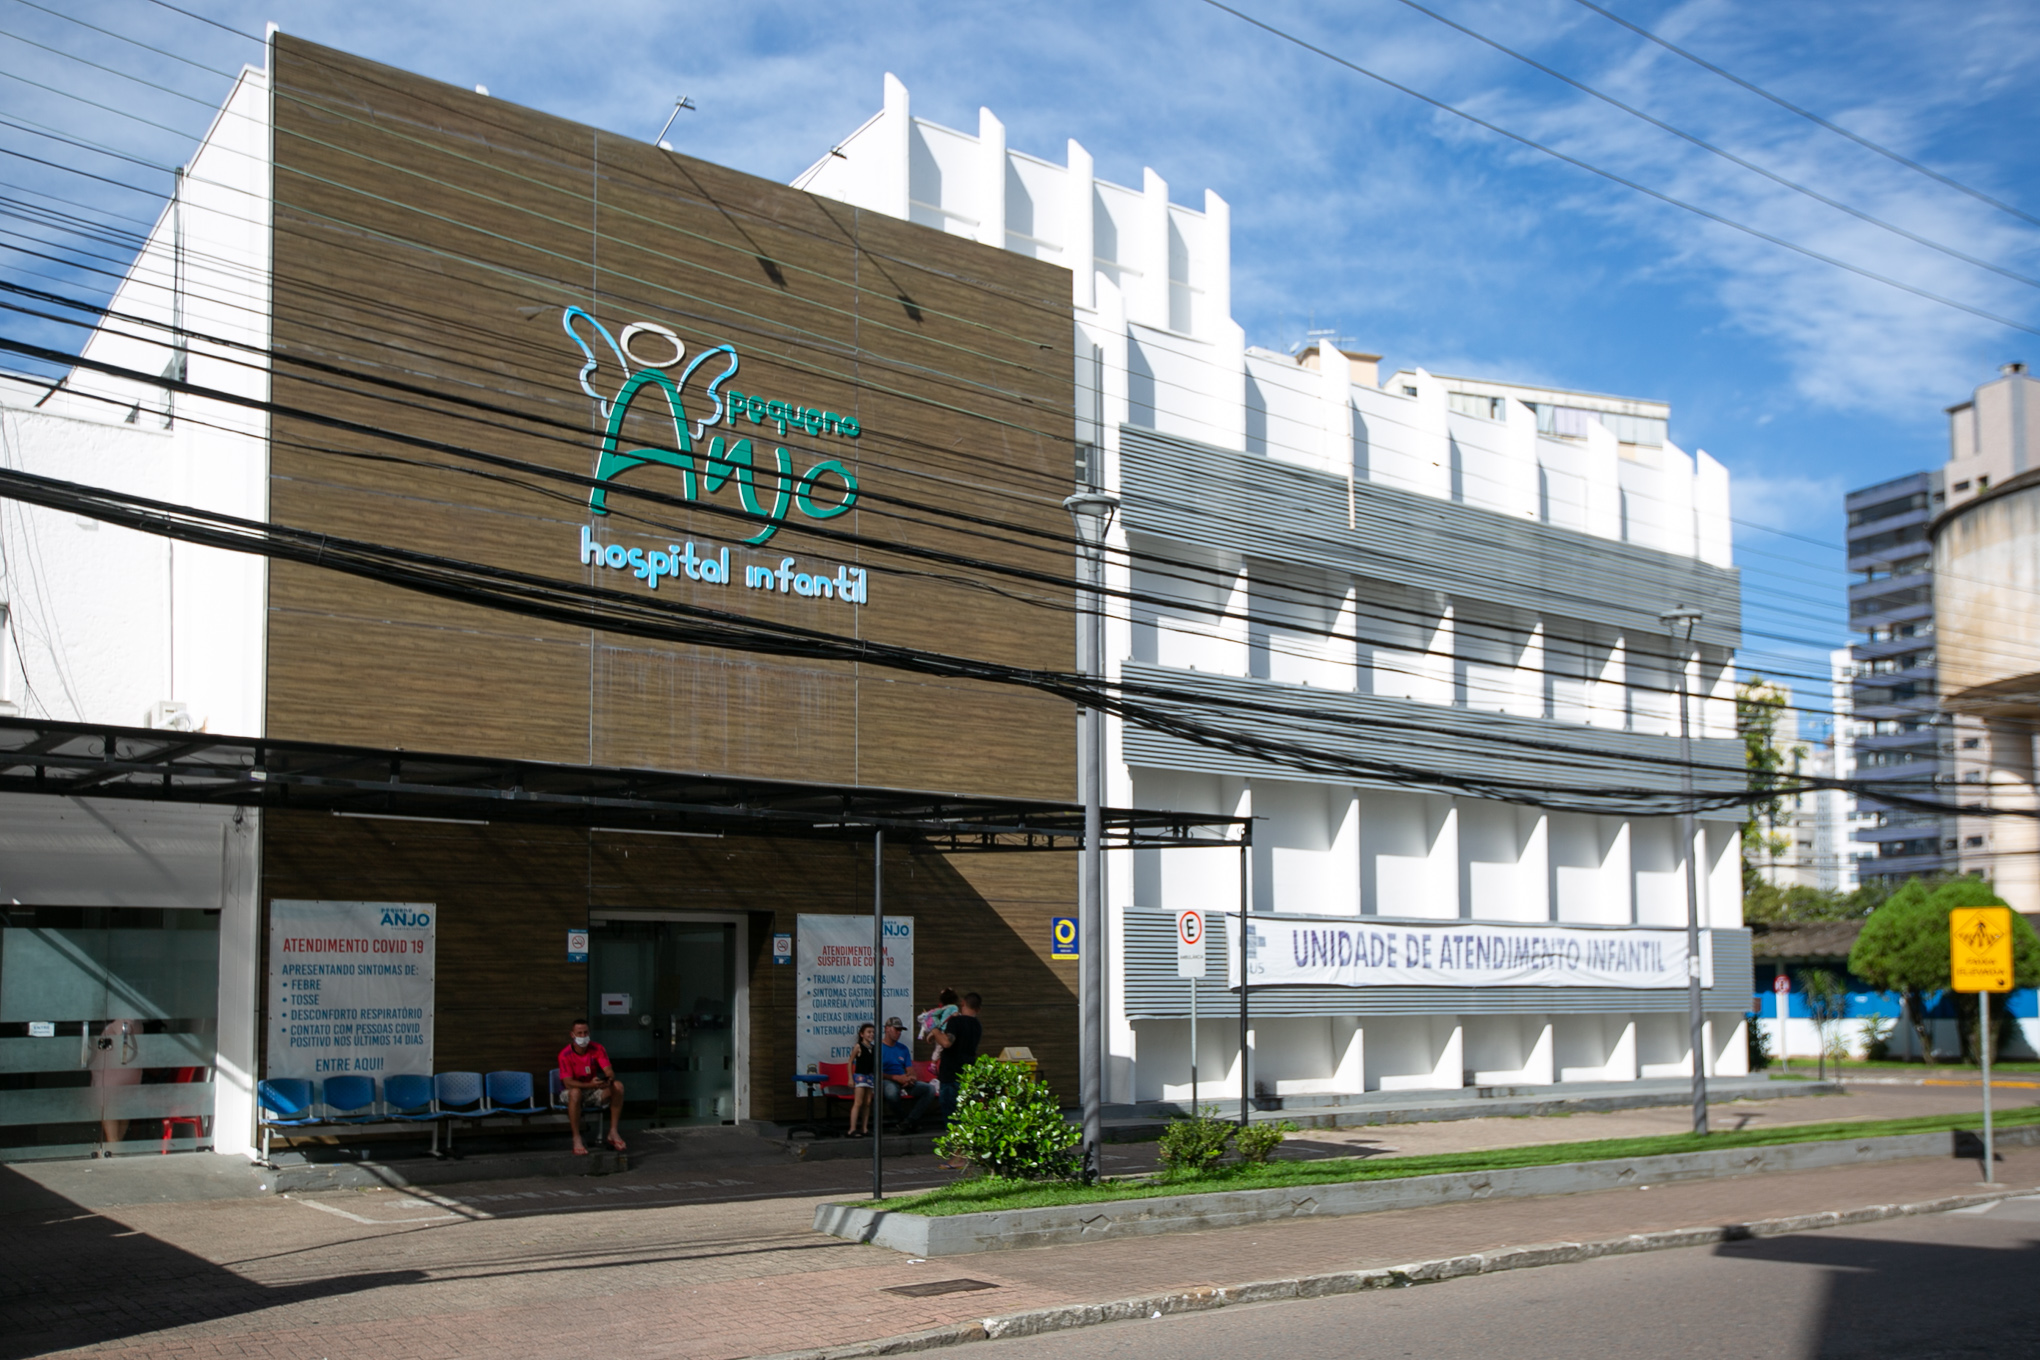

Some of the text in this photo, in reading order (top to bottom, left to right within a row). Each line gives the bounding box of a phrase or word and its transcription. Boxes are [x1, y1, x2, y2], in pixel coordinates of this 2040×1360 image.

[581, 525, 867, 605] hospital infantil
[380, 913, 430, 927] ANJO
[882, 924, 910, 937] NJO
[1186, 918, 1195, 937] E
[283, 938, 424, 953] ATENDIMENTO COVID 19
[822, 946, 872, 956] ATENDIMENTO
[1292, 930, 1665, 972] UNIDADE DE ATENDIMENTO INFANTIL
[817, 956, 851, 967] SUSPEITA
[852, 957, 862, 966] DE
[886, 957, 895, 967] 19
[282, 964, 419, 976] APRESENTANDO SINTOMAS DE:
[291, 979, 321, 991] FEBRE
[813, 974, 845, 984] TRAUMAS
[852, 974, 887, 984] ACIDENS
[812, 987, 847, 997] SINTOMAS
[291, 994, 320, 1005] TOSSE
[291, 1006, 423, 1020] DESCONFORTO RESPIRATÓRIO
[812, 1010, 875, 1022] QUEIXAS URINÁRIA
[290, 1023, 420, 1035] CONTATO COM PESSOAS COVID
[812, 1024, 855, 1036] INTERNAÇÃO
[290, 1034, 424, 1048] POSITIVO NOS ÚLTIMOS 14 DIAS
[315, 1057, 384, 1072] ENTRE AQUI!
